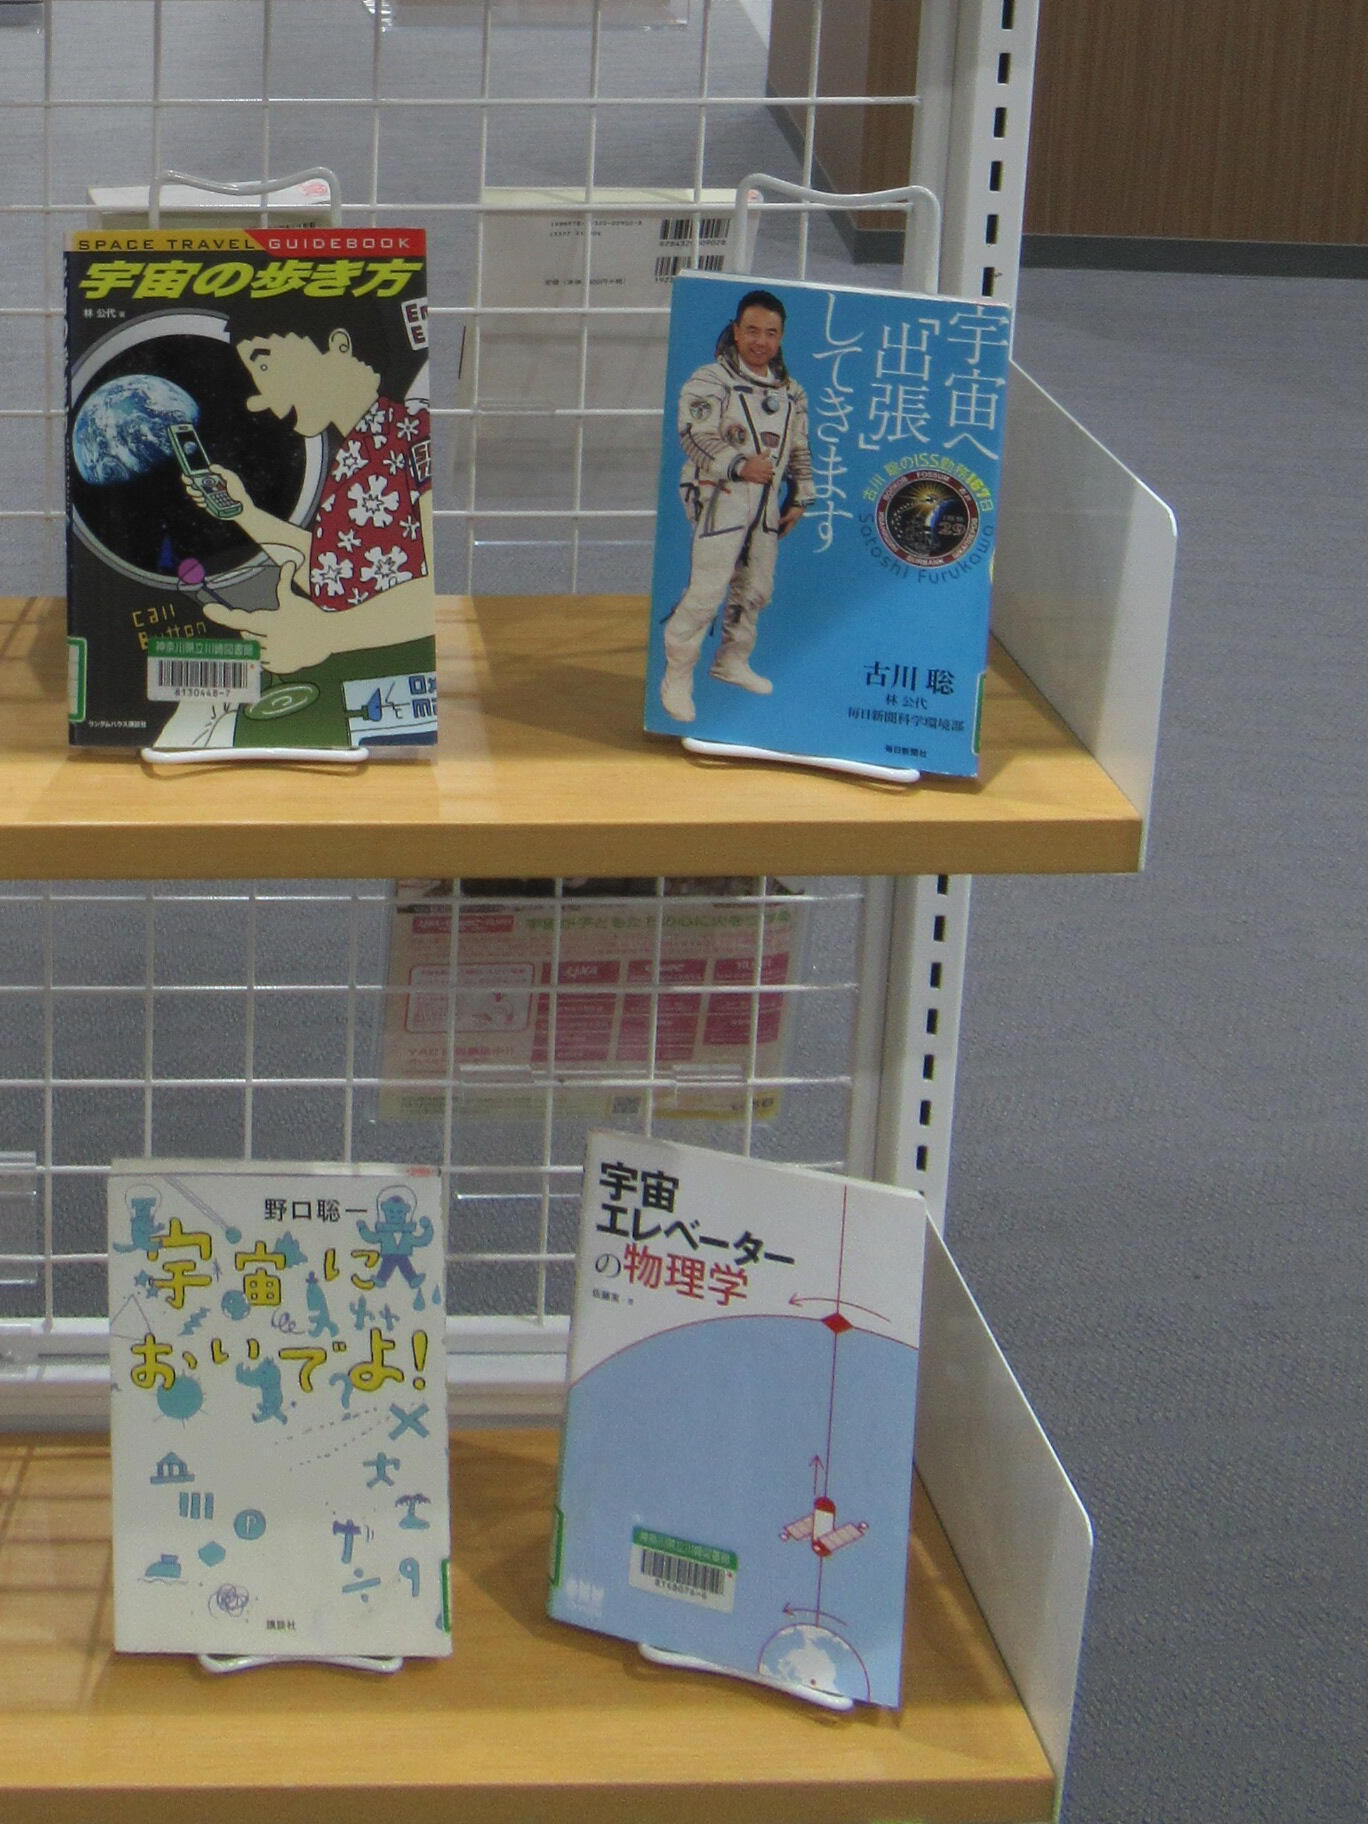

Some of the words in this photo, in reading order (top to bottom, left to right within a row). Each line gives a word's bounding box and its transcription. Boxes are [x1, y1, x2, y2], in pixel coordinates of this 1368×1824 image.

[78, 239, 155, 251] SPACE
[167, 238, 257, 250] TRAVEL
[268, 237, 411, 250] GUIDEBOOK
[78, 258, 425, 300] 宇宙の歩き方
[858, 318, 940, 451] 「出張」
[944, 305, 1009, 460] 宇宙へ
[804, 292, 864, 553] してきます
[132, 603, 176, 629] Call
[864, 661, 917, 692] 古川
[926, 668, 955, 696] 聡
[264, 1198, 368, 1223] 野口聡一
[599, 1161, 680, 1214] 宇宙
[595, 1202, 795, 1266] エレベーター
[146, 1217, 382, 1310] 宇宙に
[594, 1242, 749, 1306] の物理学
[130, 1327, 430, 1393] おいでよ!
[265, 1619, 296, 1631] 講談社
